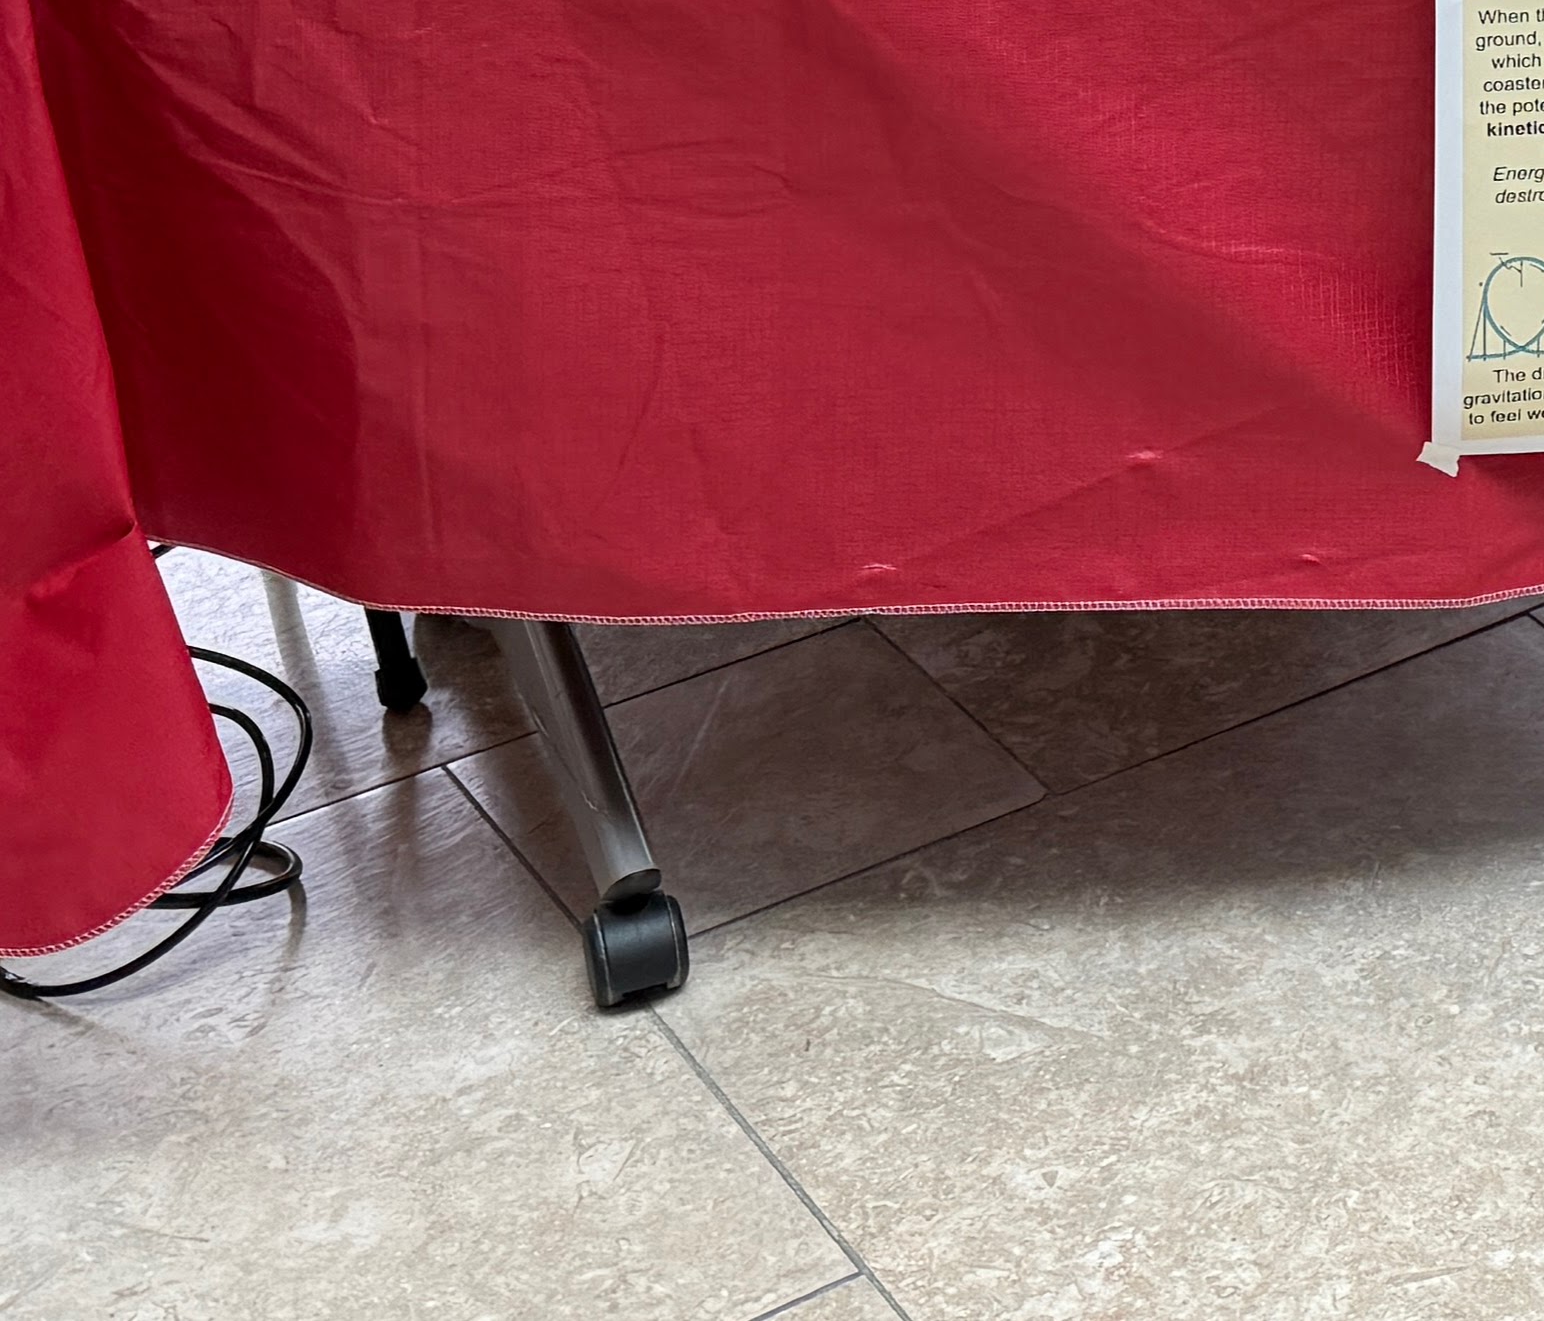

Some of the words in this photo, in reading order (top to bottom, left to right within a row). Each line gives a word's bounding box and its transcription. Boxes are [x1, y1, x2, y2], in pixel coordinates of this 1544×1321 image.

[1477, 8, 1529, 25] When
[1490, 52, 1541, 69] which
[1479, 99, 1506, 115] the
